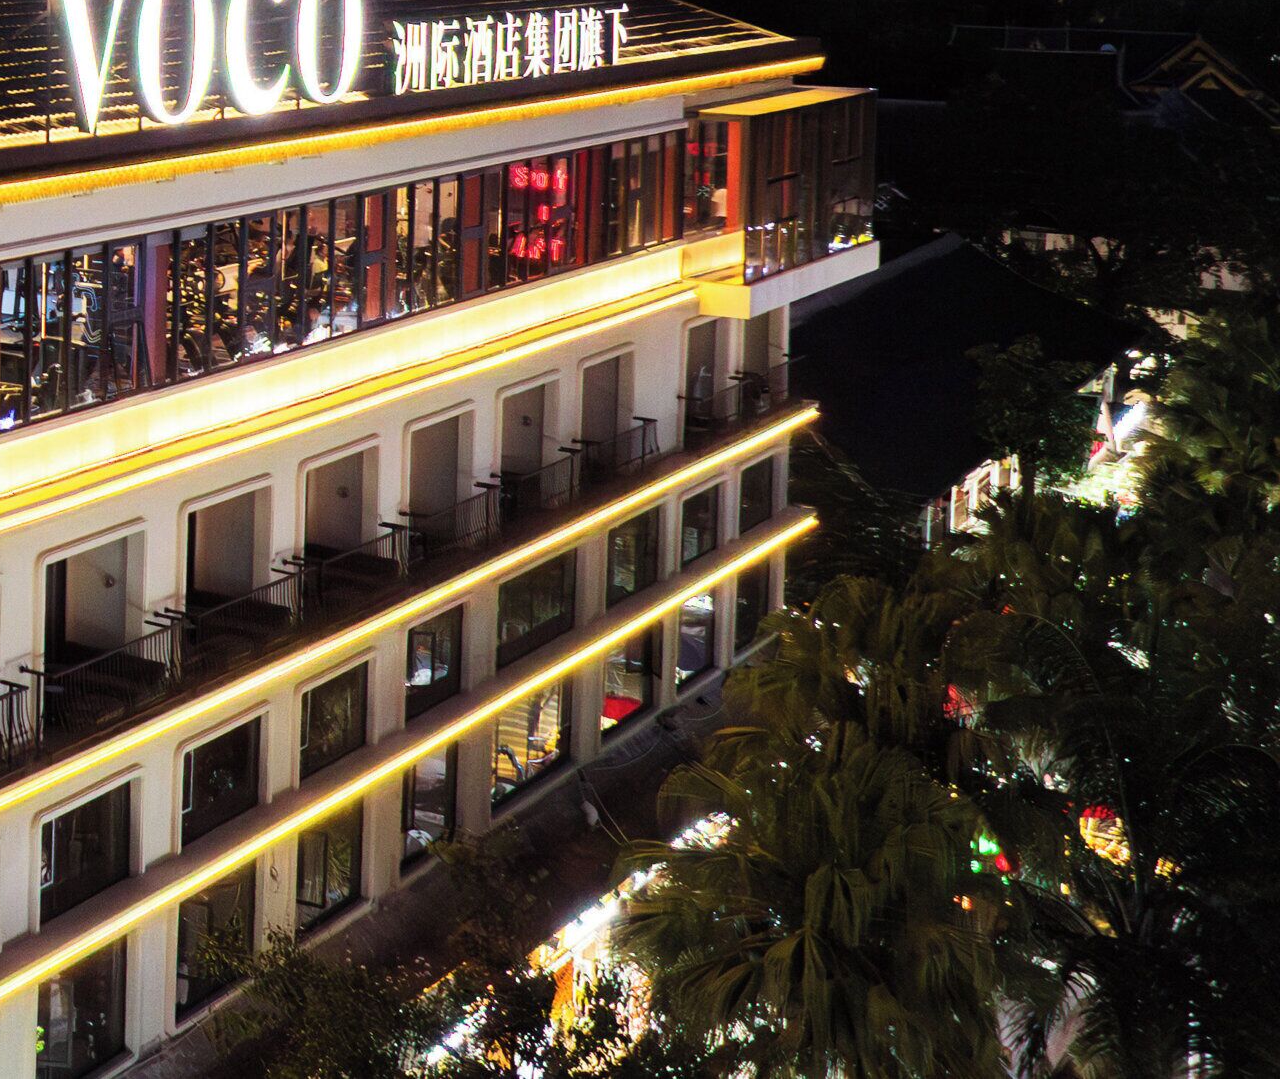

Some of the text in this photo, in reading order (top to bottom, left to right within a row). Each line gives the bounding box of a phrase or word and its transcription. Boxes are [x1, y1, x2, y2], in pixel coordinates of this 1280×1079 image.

[391, 2, 631, 96] 洲际酒店集团旗下
